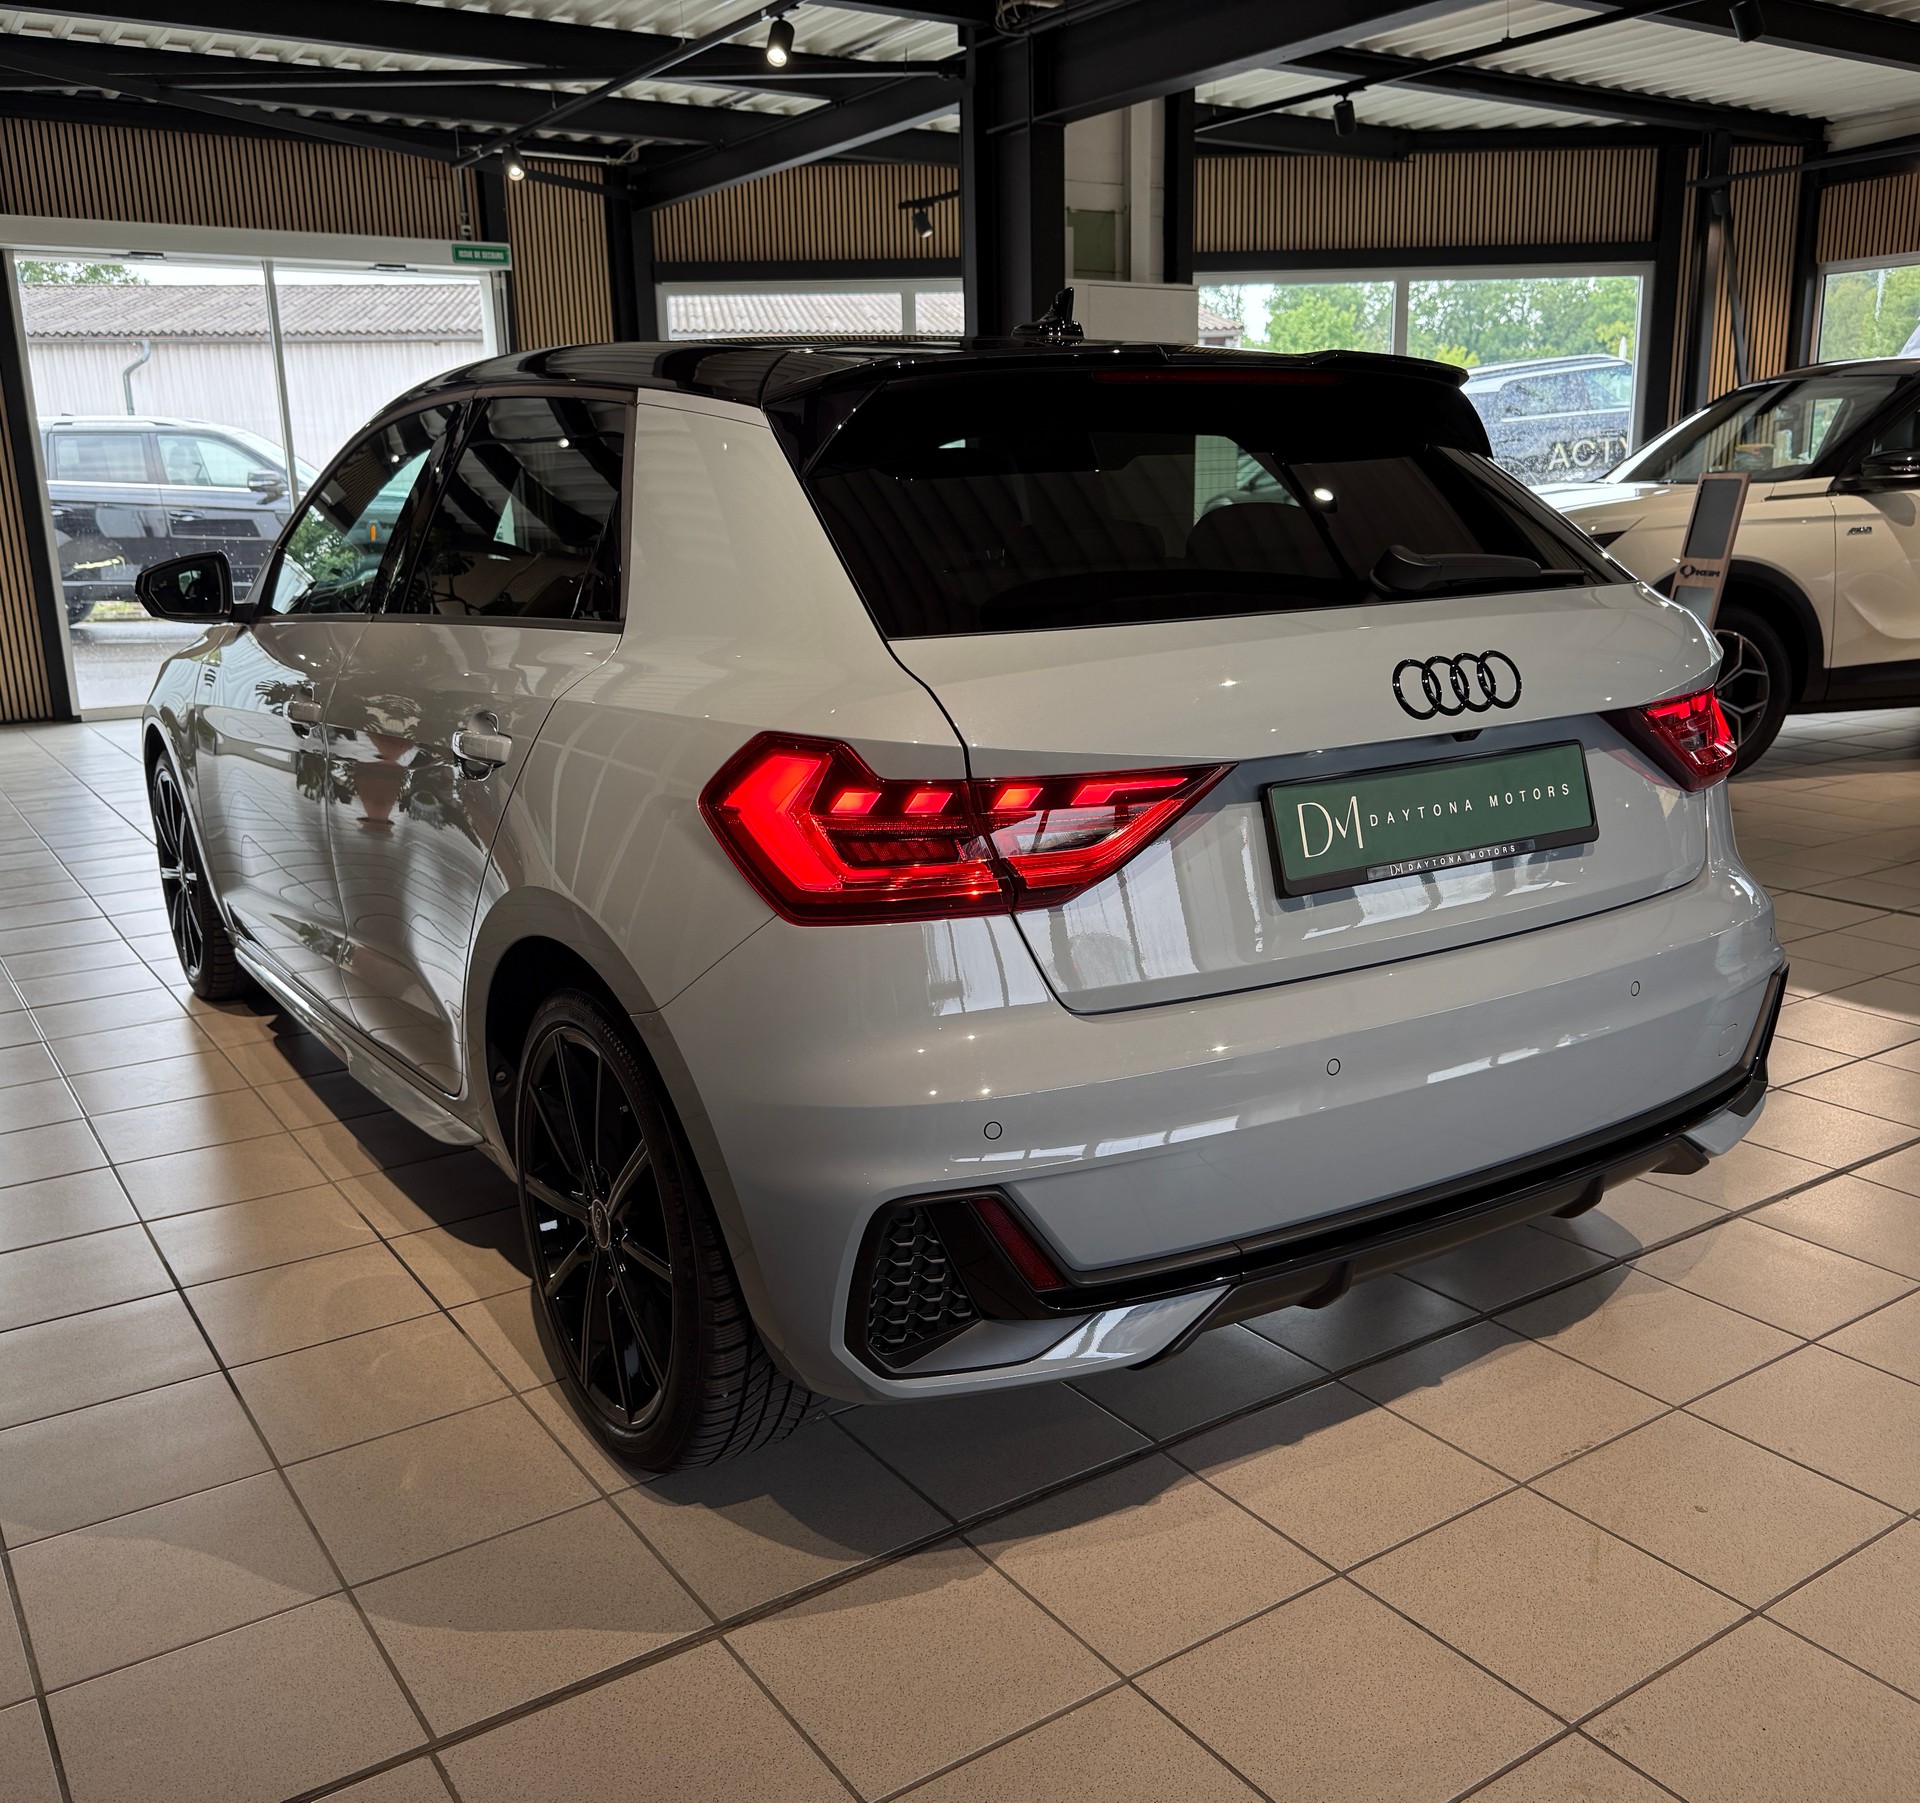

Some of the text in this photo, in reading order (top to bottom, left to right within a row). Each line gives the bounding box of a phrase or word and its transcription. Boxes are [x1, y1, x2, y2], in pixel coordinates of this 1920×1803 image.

[1297, 783, 1570, 858] DM DAYTONA MOTORS
[1408, 855, 1462, 871] DAYTONA
[1469, 845, 1516, 859] MOTORS
